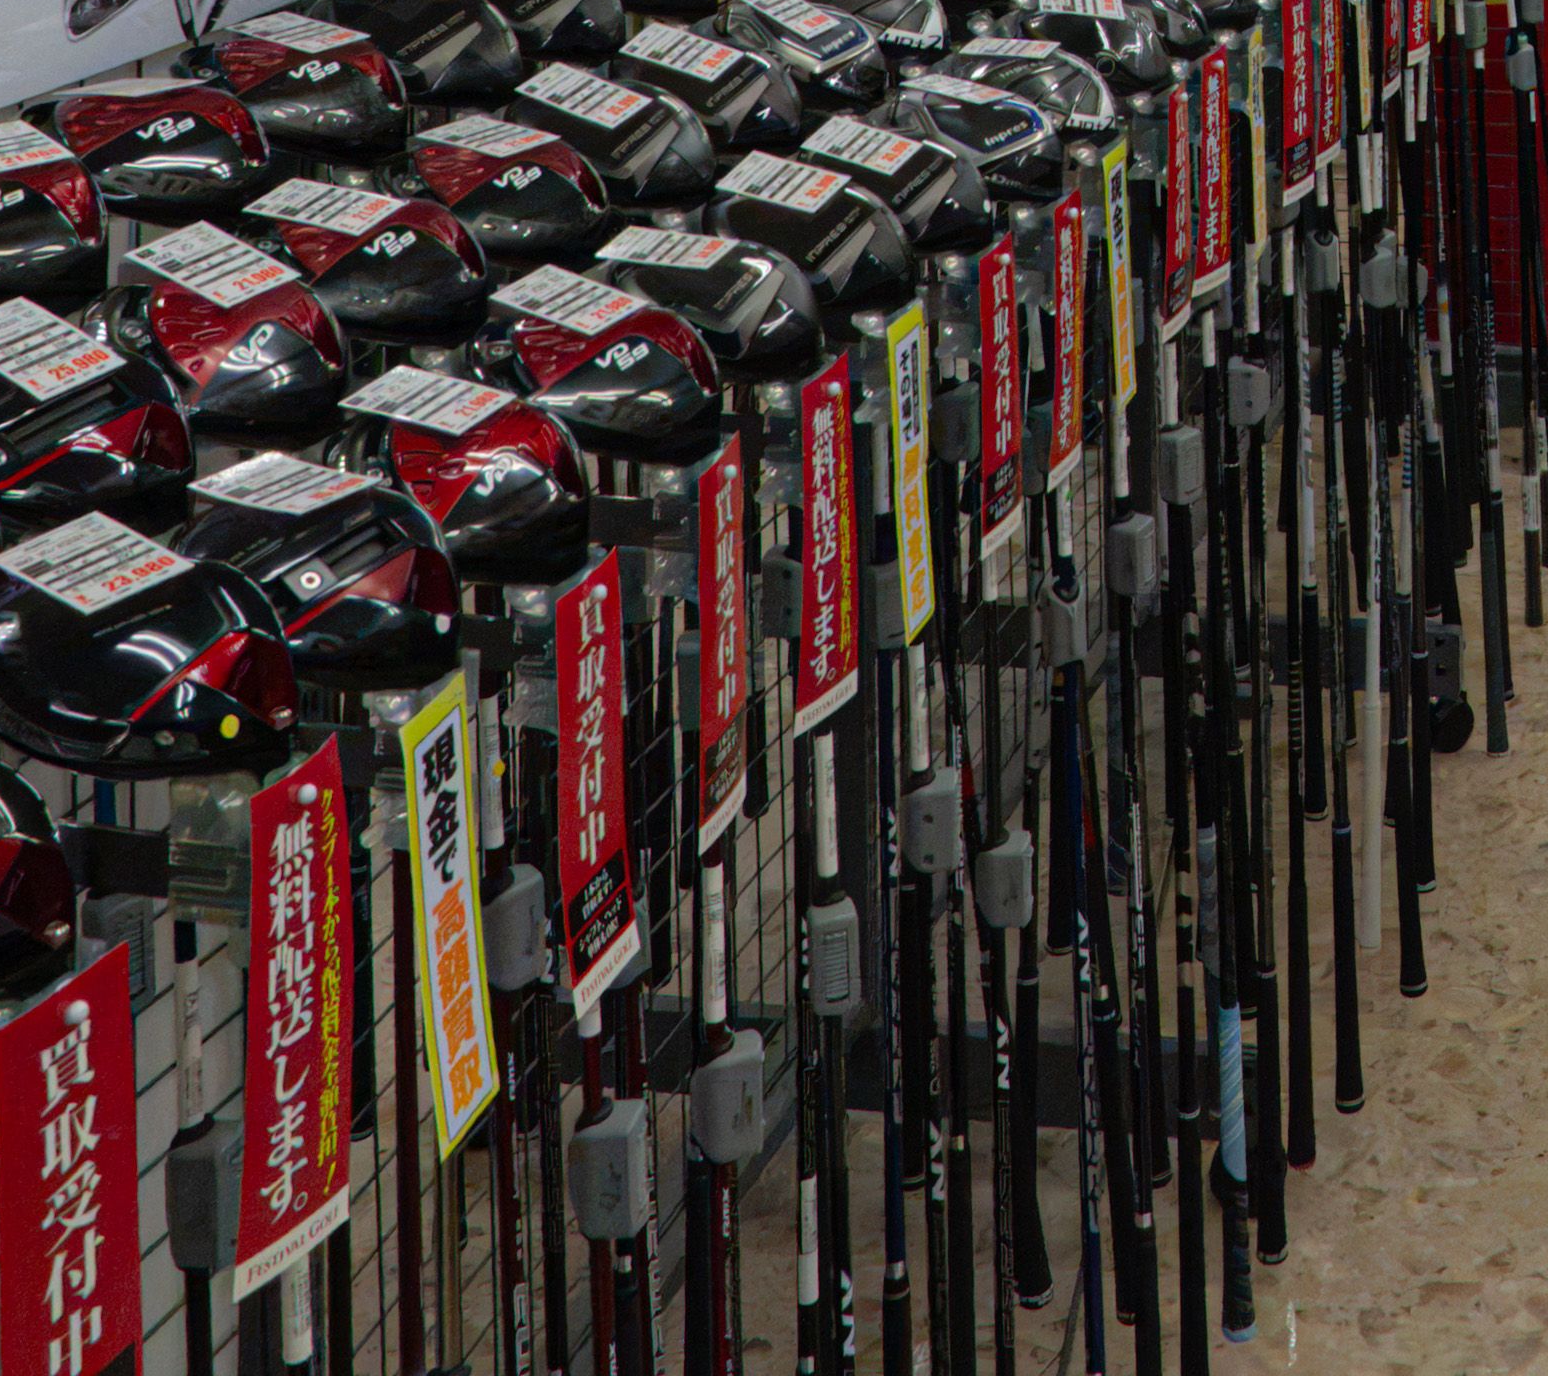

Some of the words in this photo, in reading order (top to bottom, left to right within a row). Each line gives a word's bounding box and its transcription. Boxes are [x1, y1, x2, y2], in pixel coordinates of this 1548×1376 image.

[47, 348, 110, 383] 25,980
[231, 263, 285, 297] 21,980
[101, 546, 175, 600] 23,980
[809, 404, 839, 688] 無料配送します。
[577, 593, 606, 868] 買取受付中
[259, 811, 319, 1226] 無料配送します。
[39, 1018, 105, 1376] 買取受付中
